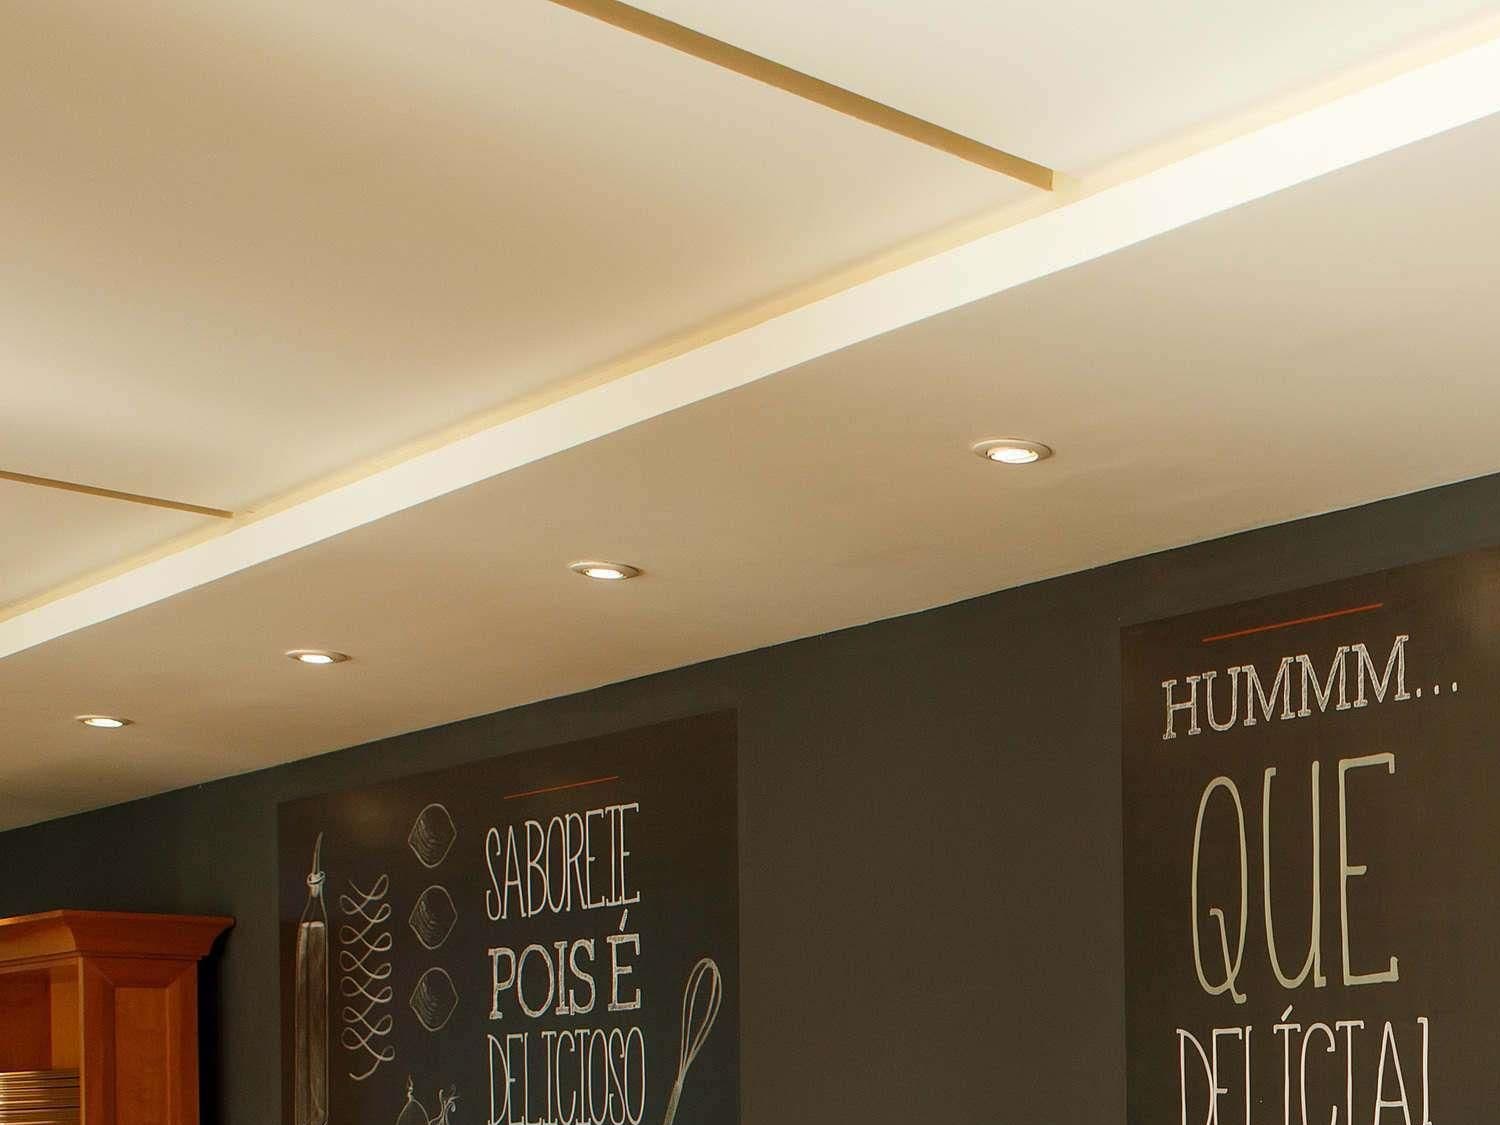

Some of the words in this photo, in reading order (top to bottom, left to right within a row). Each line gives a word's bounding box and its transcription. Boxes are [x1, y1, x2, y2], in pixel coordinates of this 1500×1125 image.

[1162, 634, 1459, 739] HUMMM...
[1191, 752, 1400, 1004] QUE
[487, 938, 597, 1020] POIS
[606, 908, 642, 1013] É
